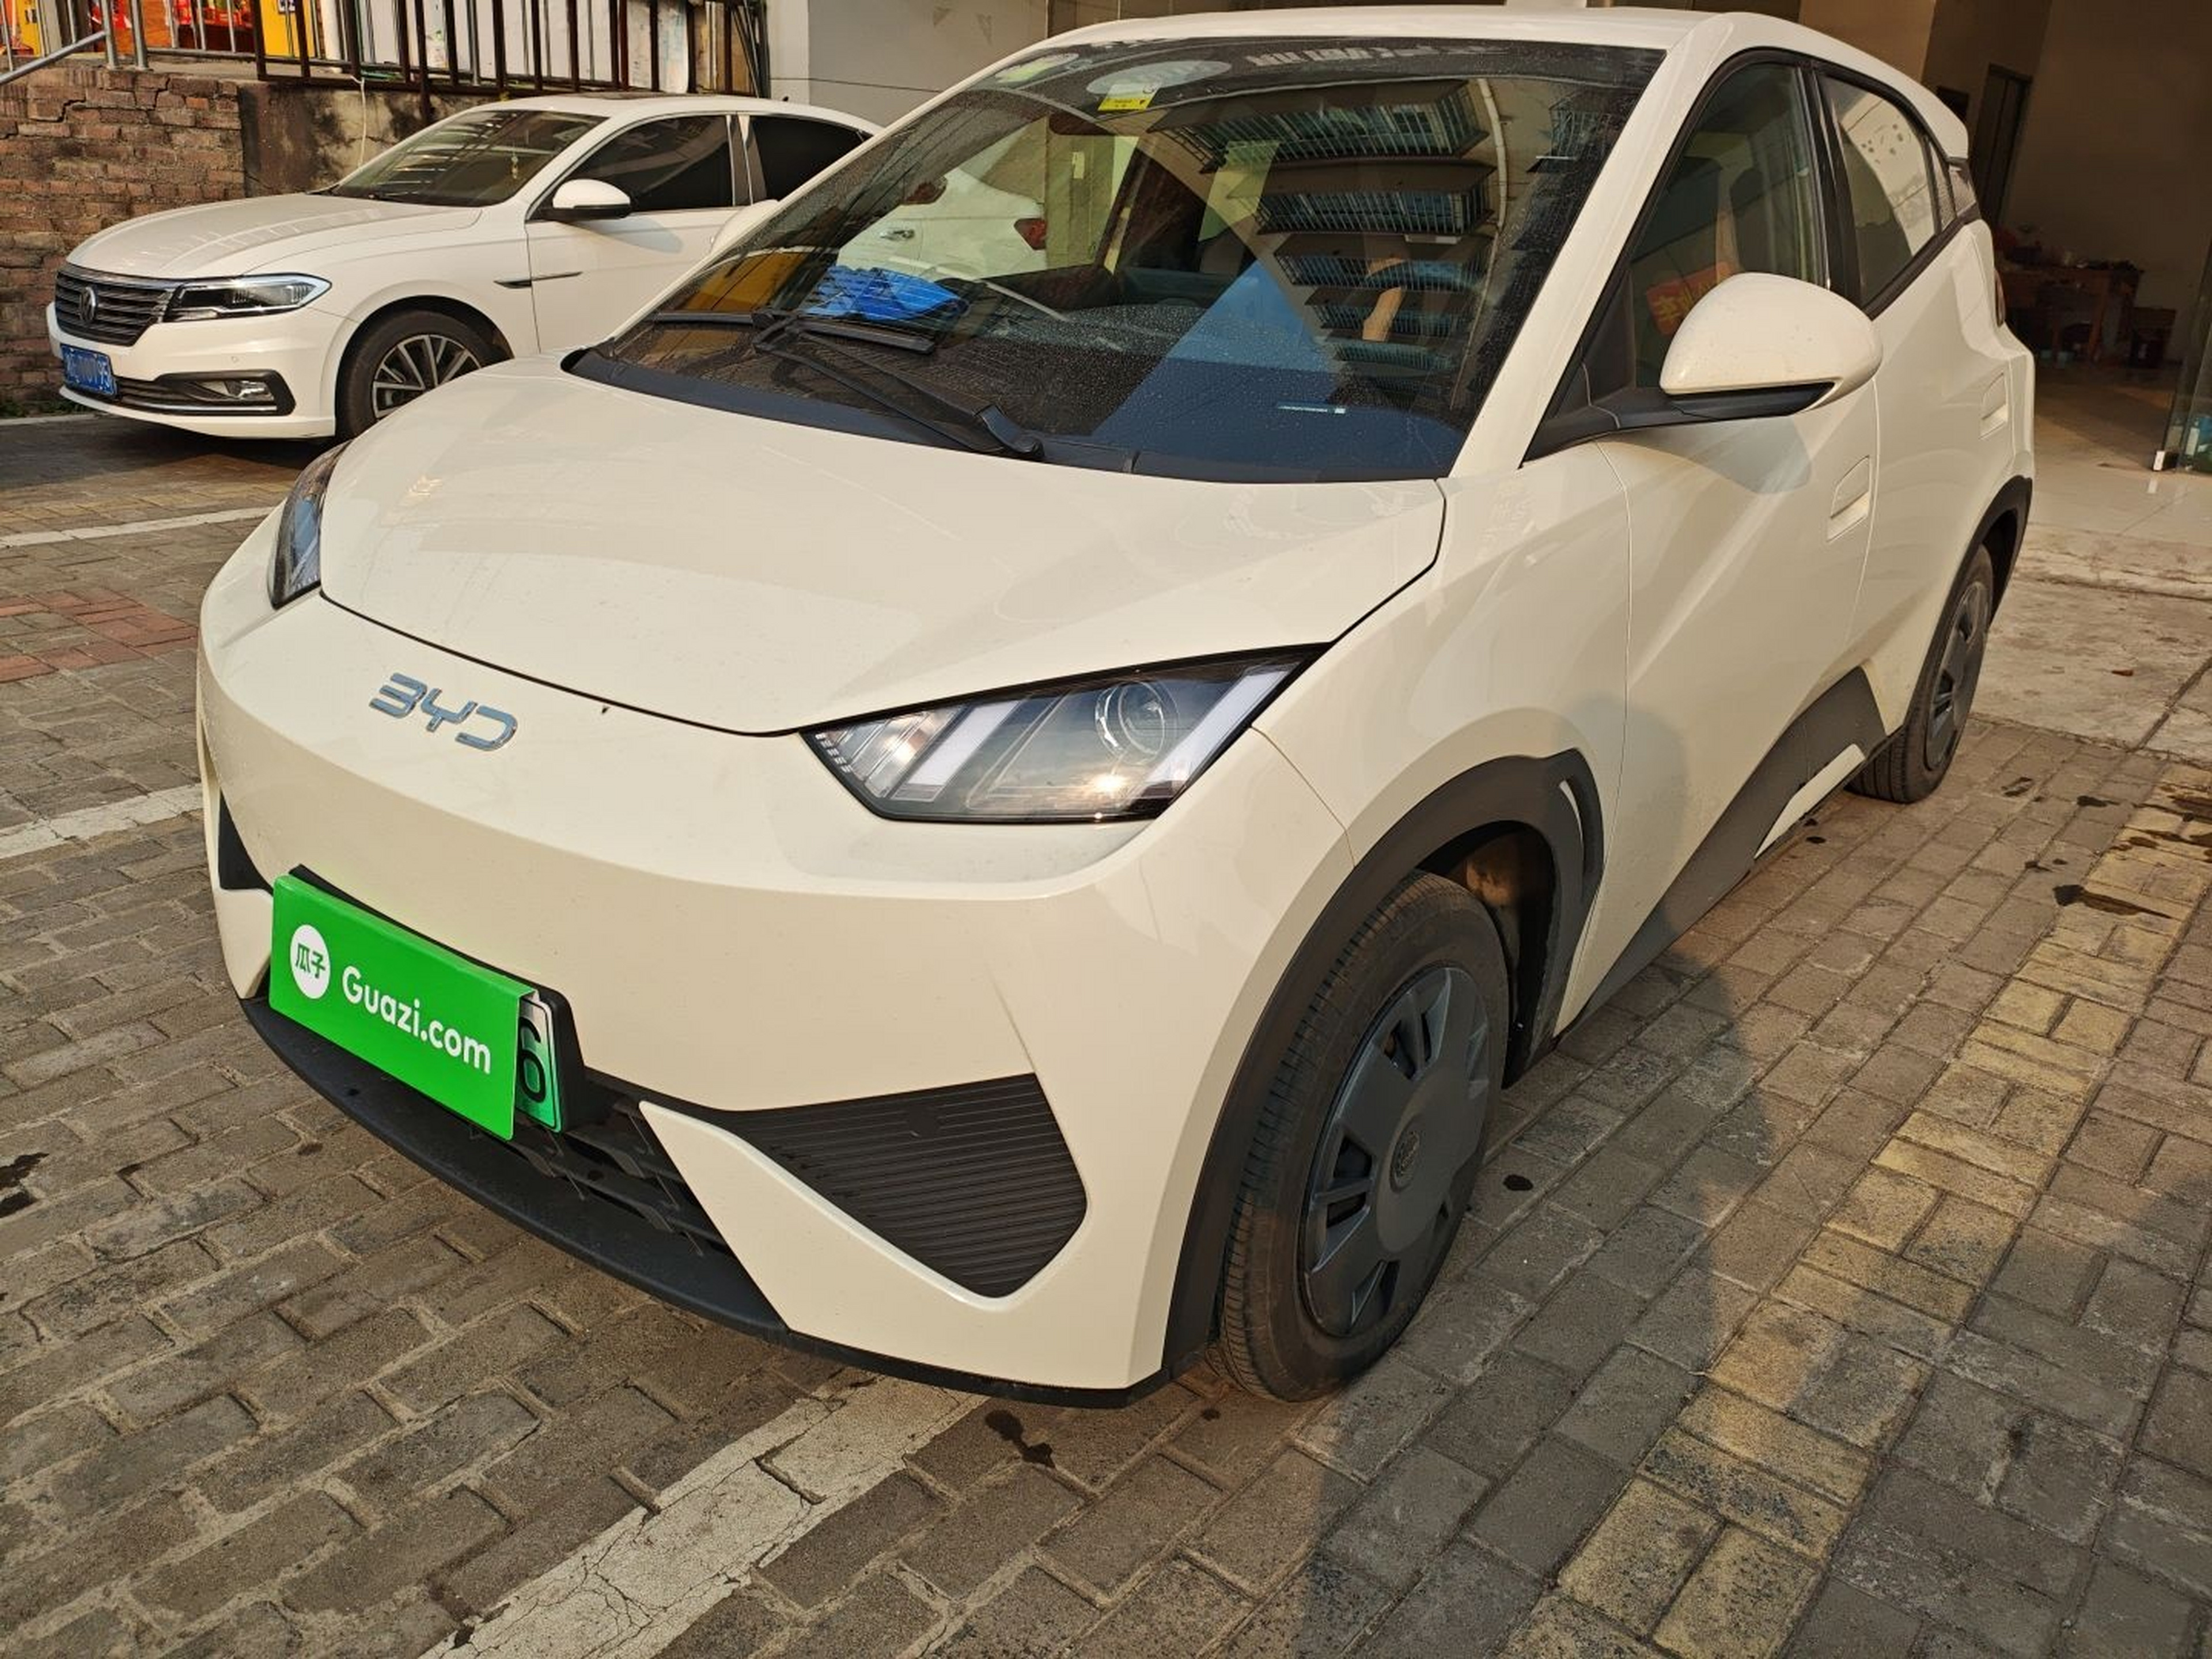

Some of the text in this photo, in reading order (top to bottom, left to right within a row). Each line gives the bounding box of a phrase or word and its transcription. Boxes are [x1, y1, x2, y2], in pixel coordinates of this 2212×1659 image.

[369, 672, 518, 752] BYD
[296, 942, 326, 979] 瓜子
[342, 965, 490, 1074] Guazi.com
